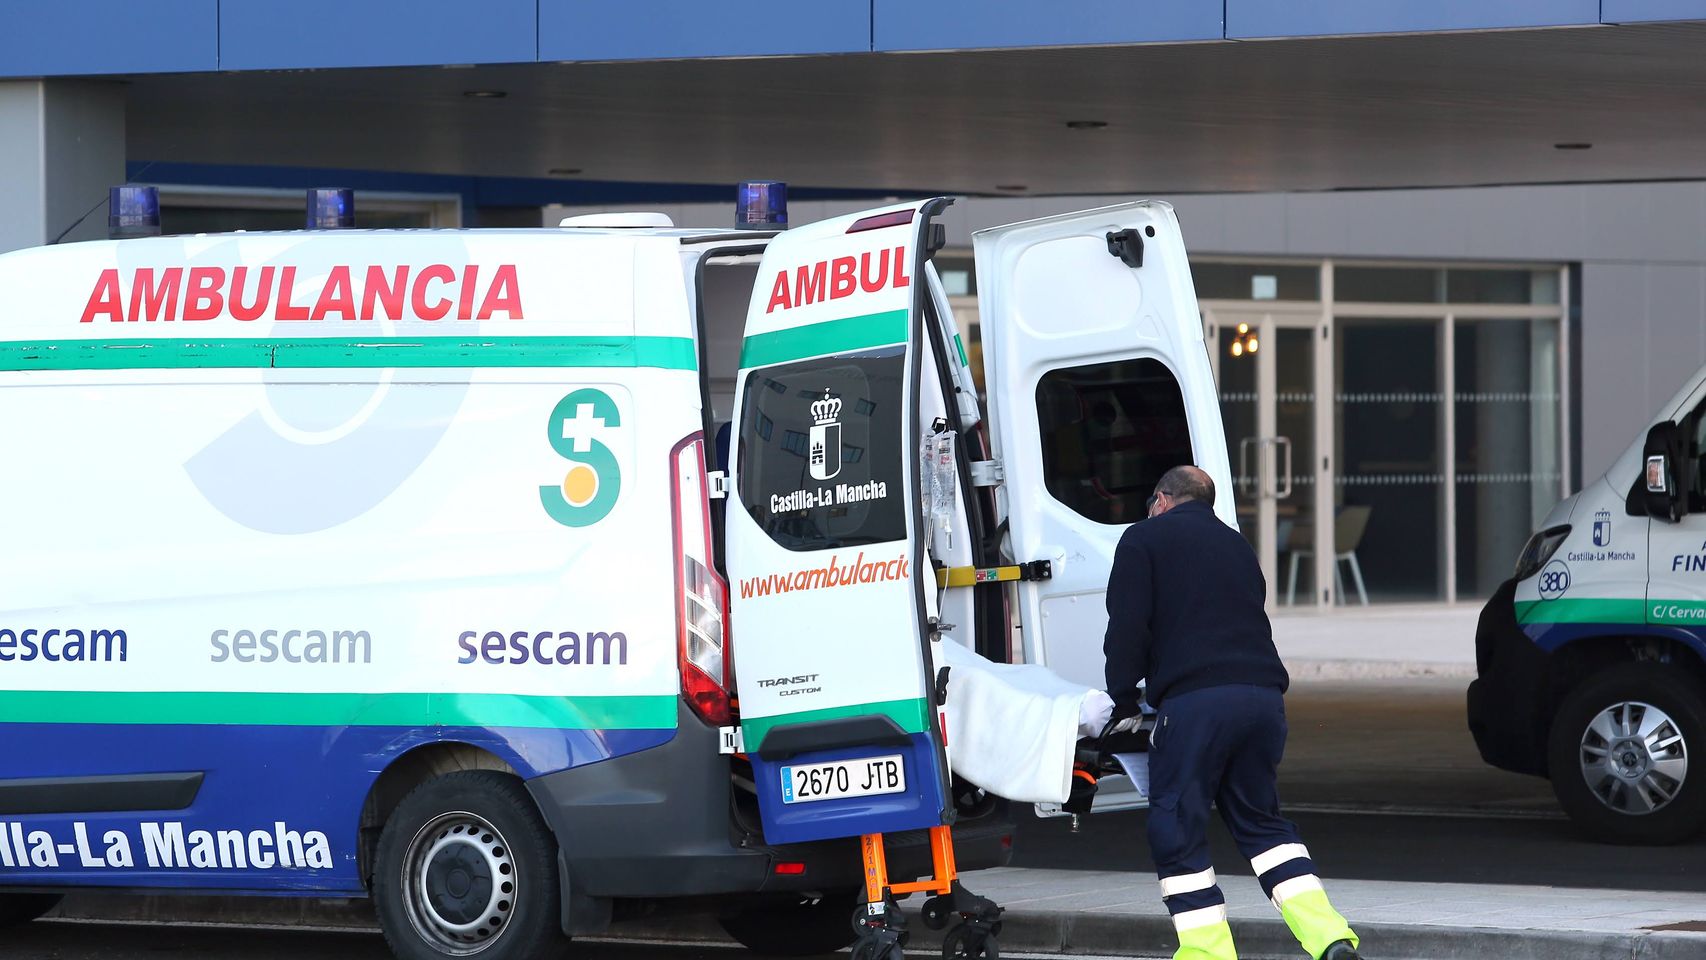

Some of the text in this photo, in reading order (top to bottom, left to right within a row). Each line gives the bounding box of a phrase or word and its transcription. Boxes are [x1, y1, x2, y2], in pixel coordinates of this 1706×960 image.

[80, 264, 523, 323] AMBULANCIA
[766, 245, 910, 314] AMBUL
[770, 480, 887, 514] Castilla-La Mancha
[1567, 551, 1636, 562] Castilla-La Mancha
[1540, 571, 1569, 592] 380
[1668, 606, 1706, 619] Cerva
[210, 629, 372, 664] sescam
[457, 630, 628, 665] sescam
[756, 673, 820, 688] TRANSIT
[779, 686, 822, 697] CUSTOM
[796, 765, 849, 797] 2670
[861, 760, 899, 790] JTB
[140, 821, 334, 869] Mancha
